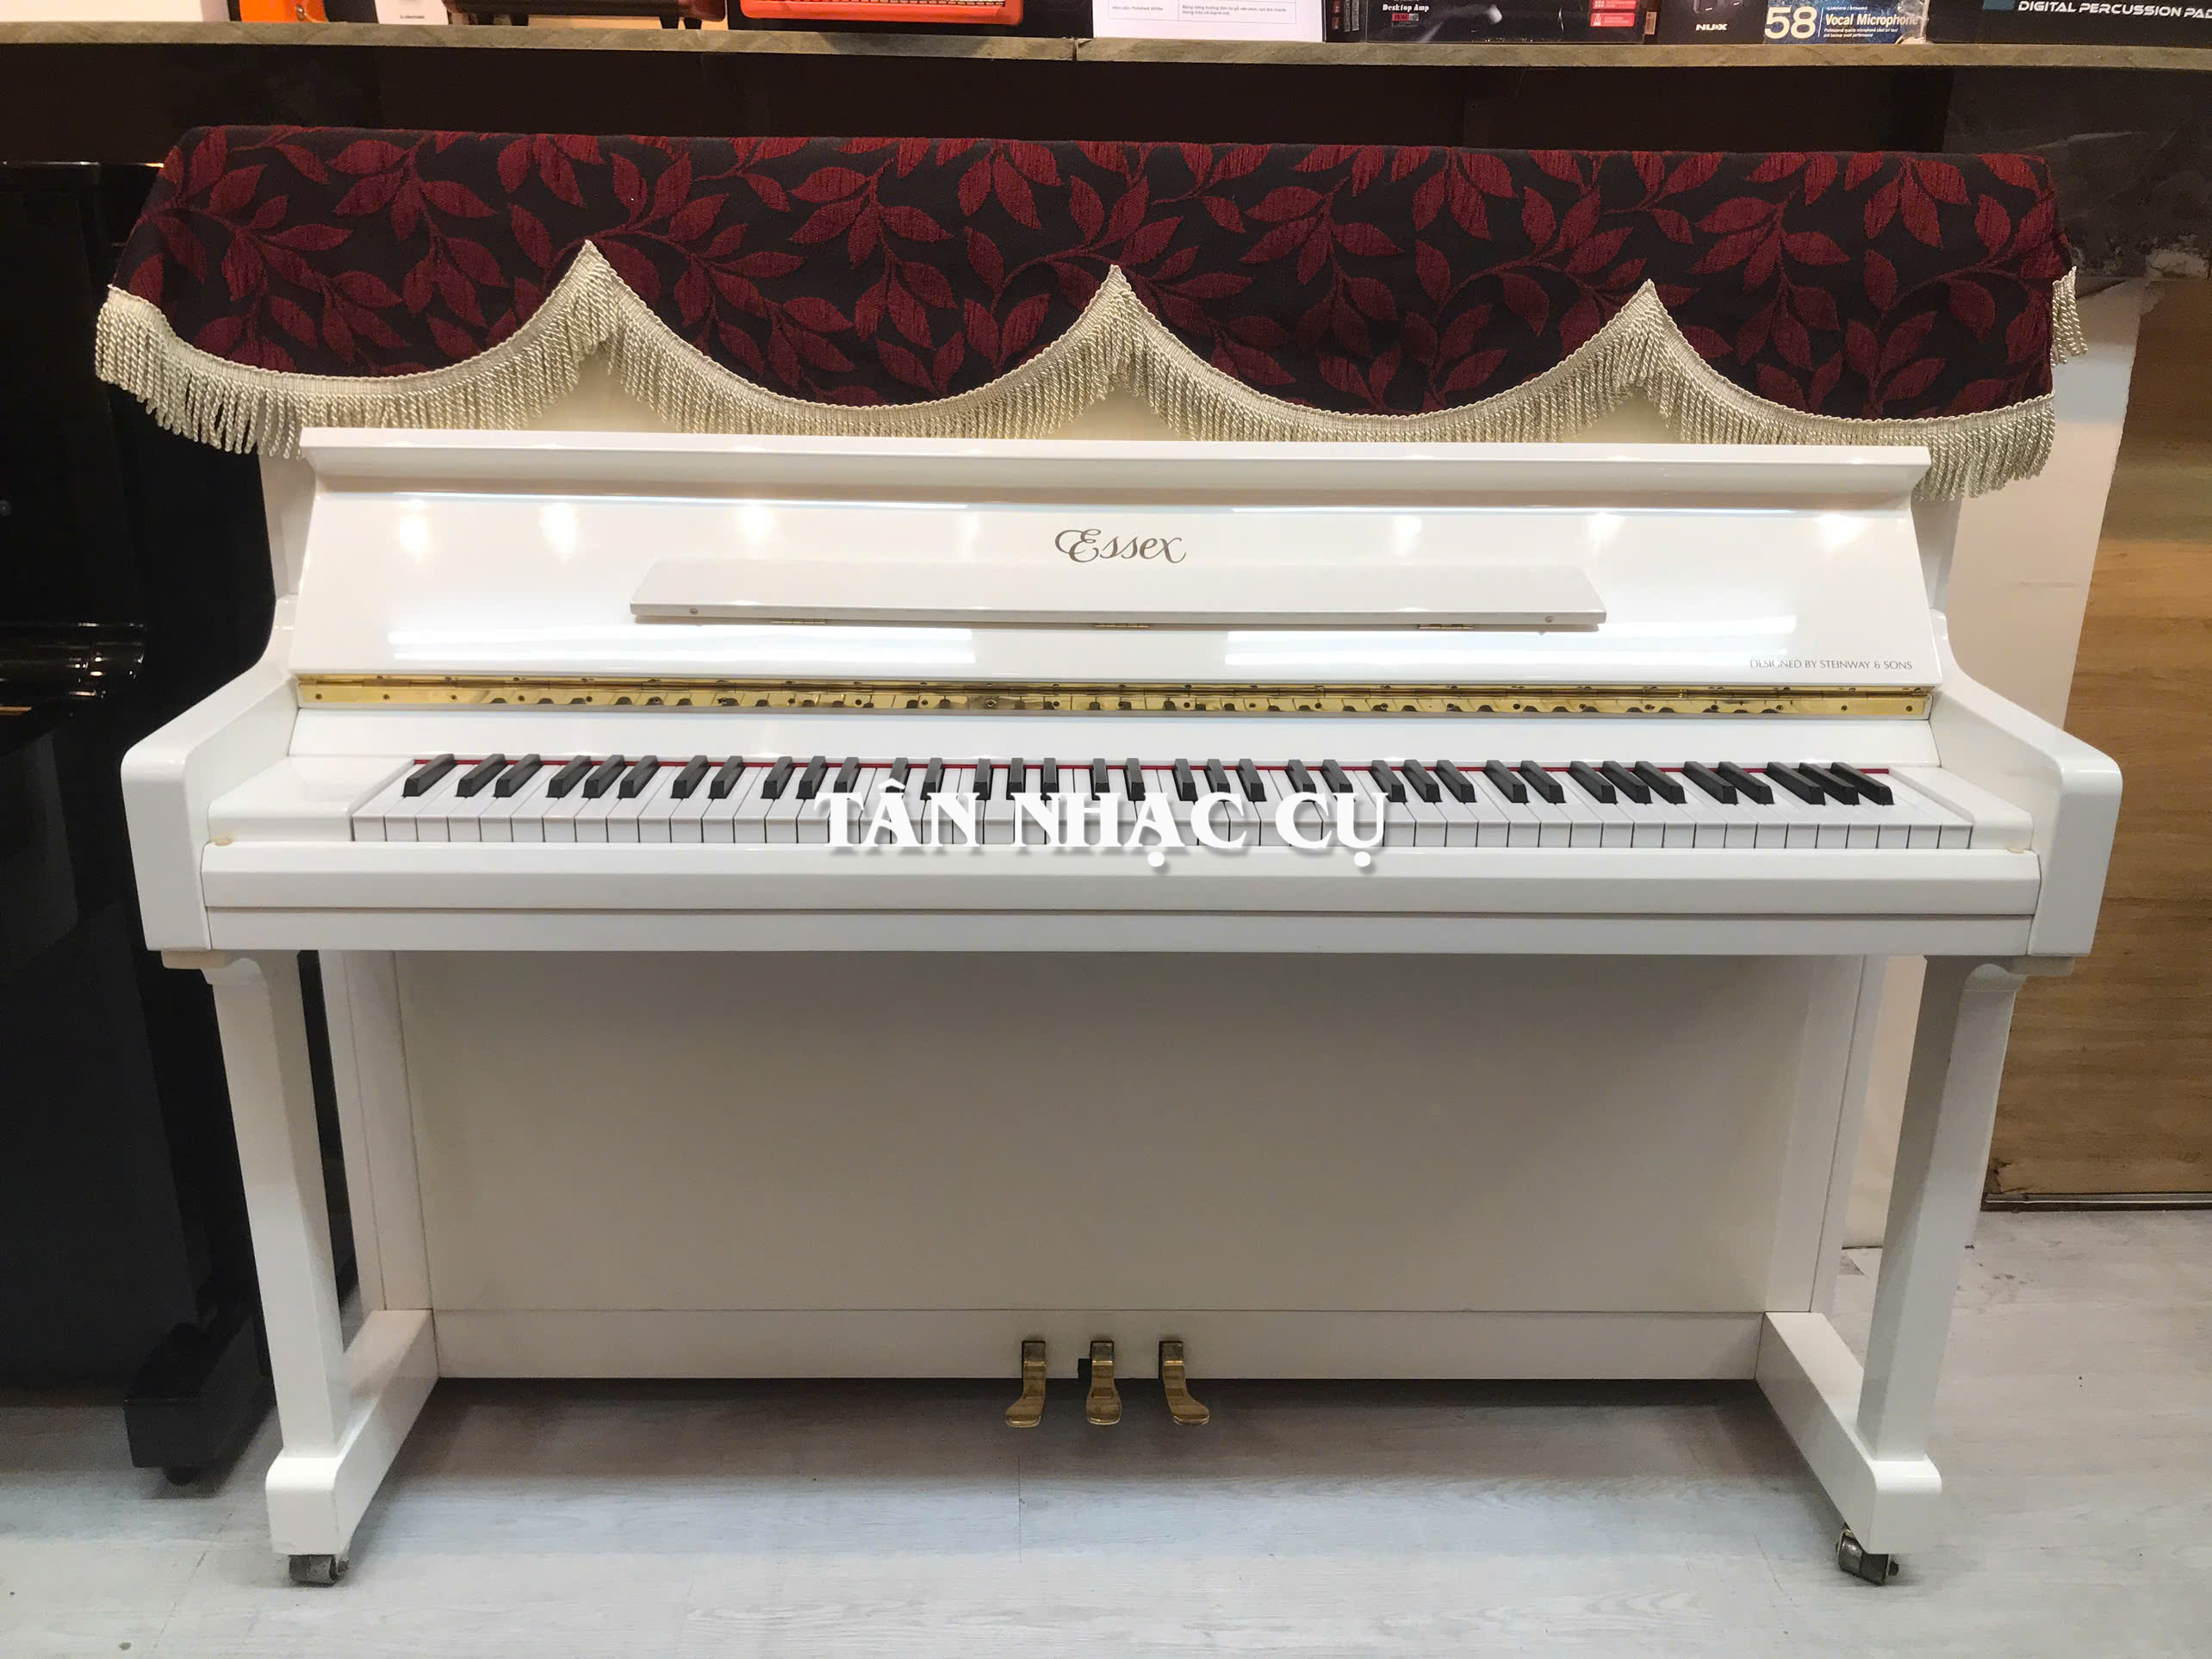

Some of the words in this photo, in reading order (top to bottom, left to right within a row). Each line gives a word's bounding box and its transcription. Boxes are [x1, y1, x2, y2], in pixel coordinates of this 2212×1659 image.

[1382, 3, 1413, 12] Desktop
[1414, 3, 1430, 13] Amp
[2017, 1, 2077, 13] DIGITAL
[2078, 3, 2182, 17] PERCUSSION
[1764, 6, 1817, 40] 58
[1825, 13, 1854, 26] Vocal
[1856, 14, 1918, 28] Microphone
[1055, 528, 1187, 564] Essex
[1749, 659, 1802, 668] DESIGNED
[1805, 660, 1817, 668] BY
[1819, 660, 1870, 669] STEINWAY
[1884, 661, 1913, 669] SONS
